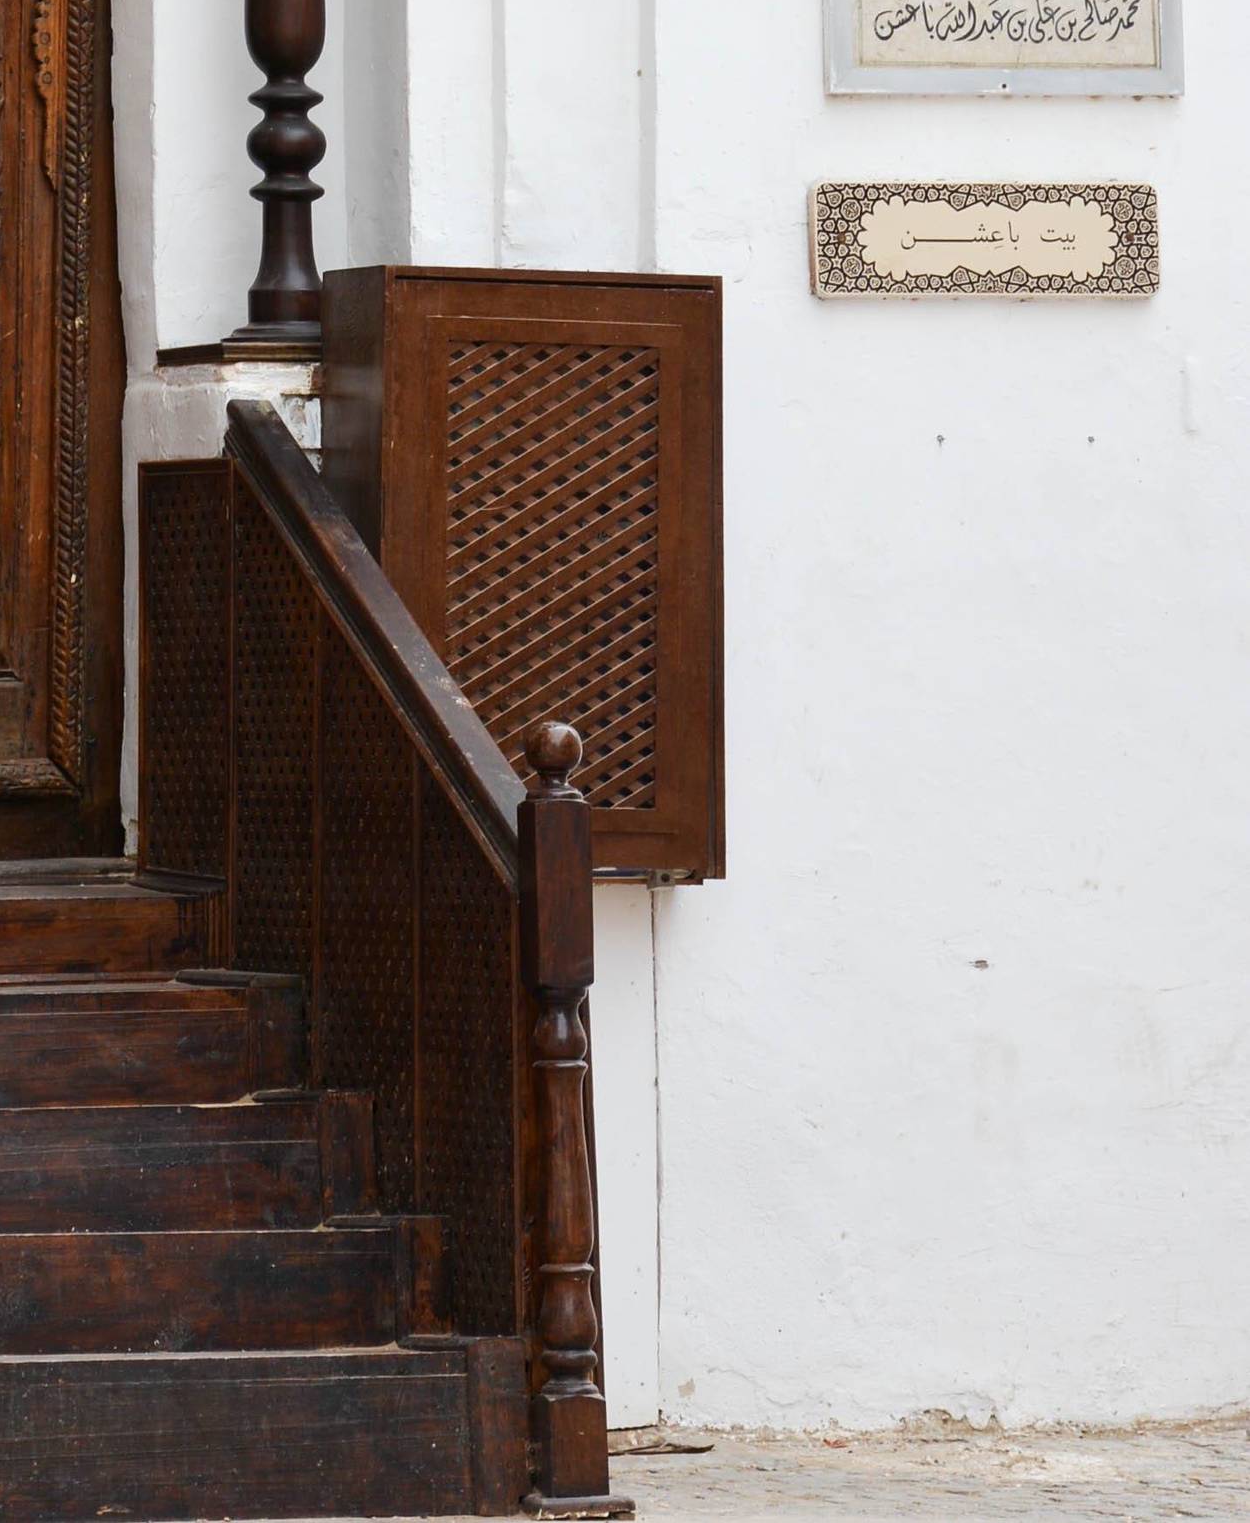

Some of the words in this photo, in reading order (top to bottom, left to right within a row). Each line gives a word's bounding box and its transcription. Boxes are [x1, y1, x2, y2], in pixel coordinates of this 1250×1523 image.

[1006, 9, 1028, 43] بن
[1054, 9, 1078, 43] بن
[1040, 228, 1077, 251] بيت
